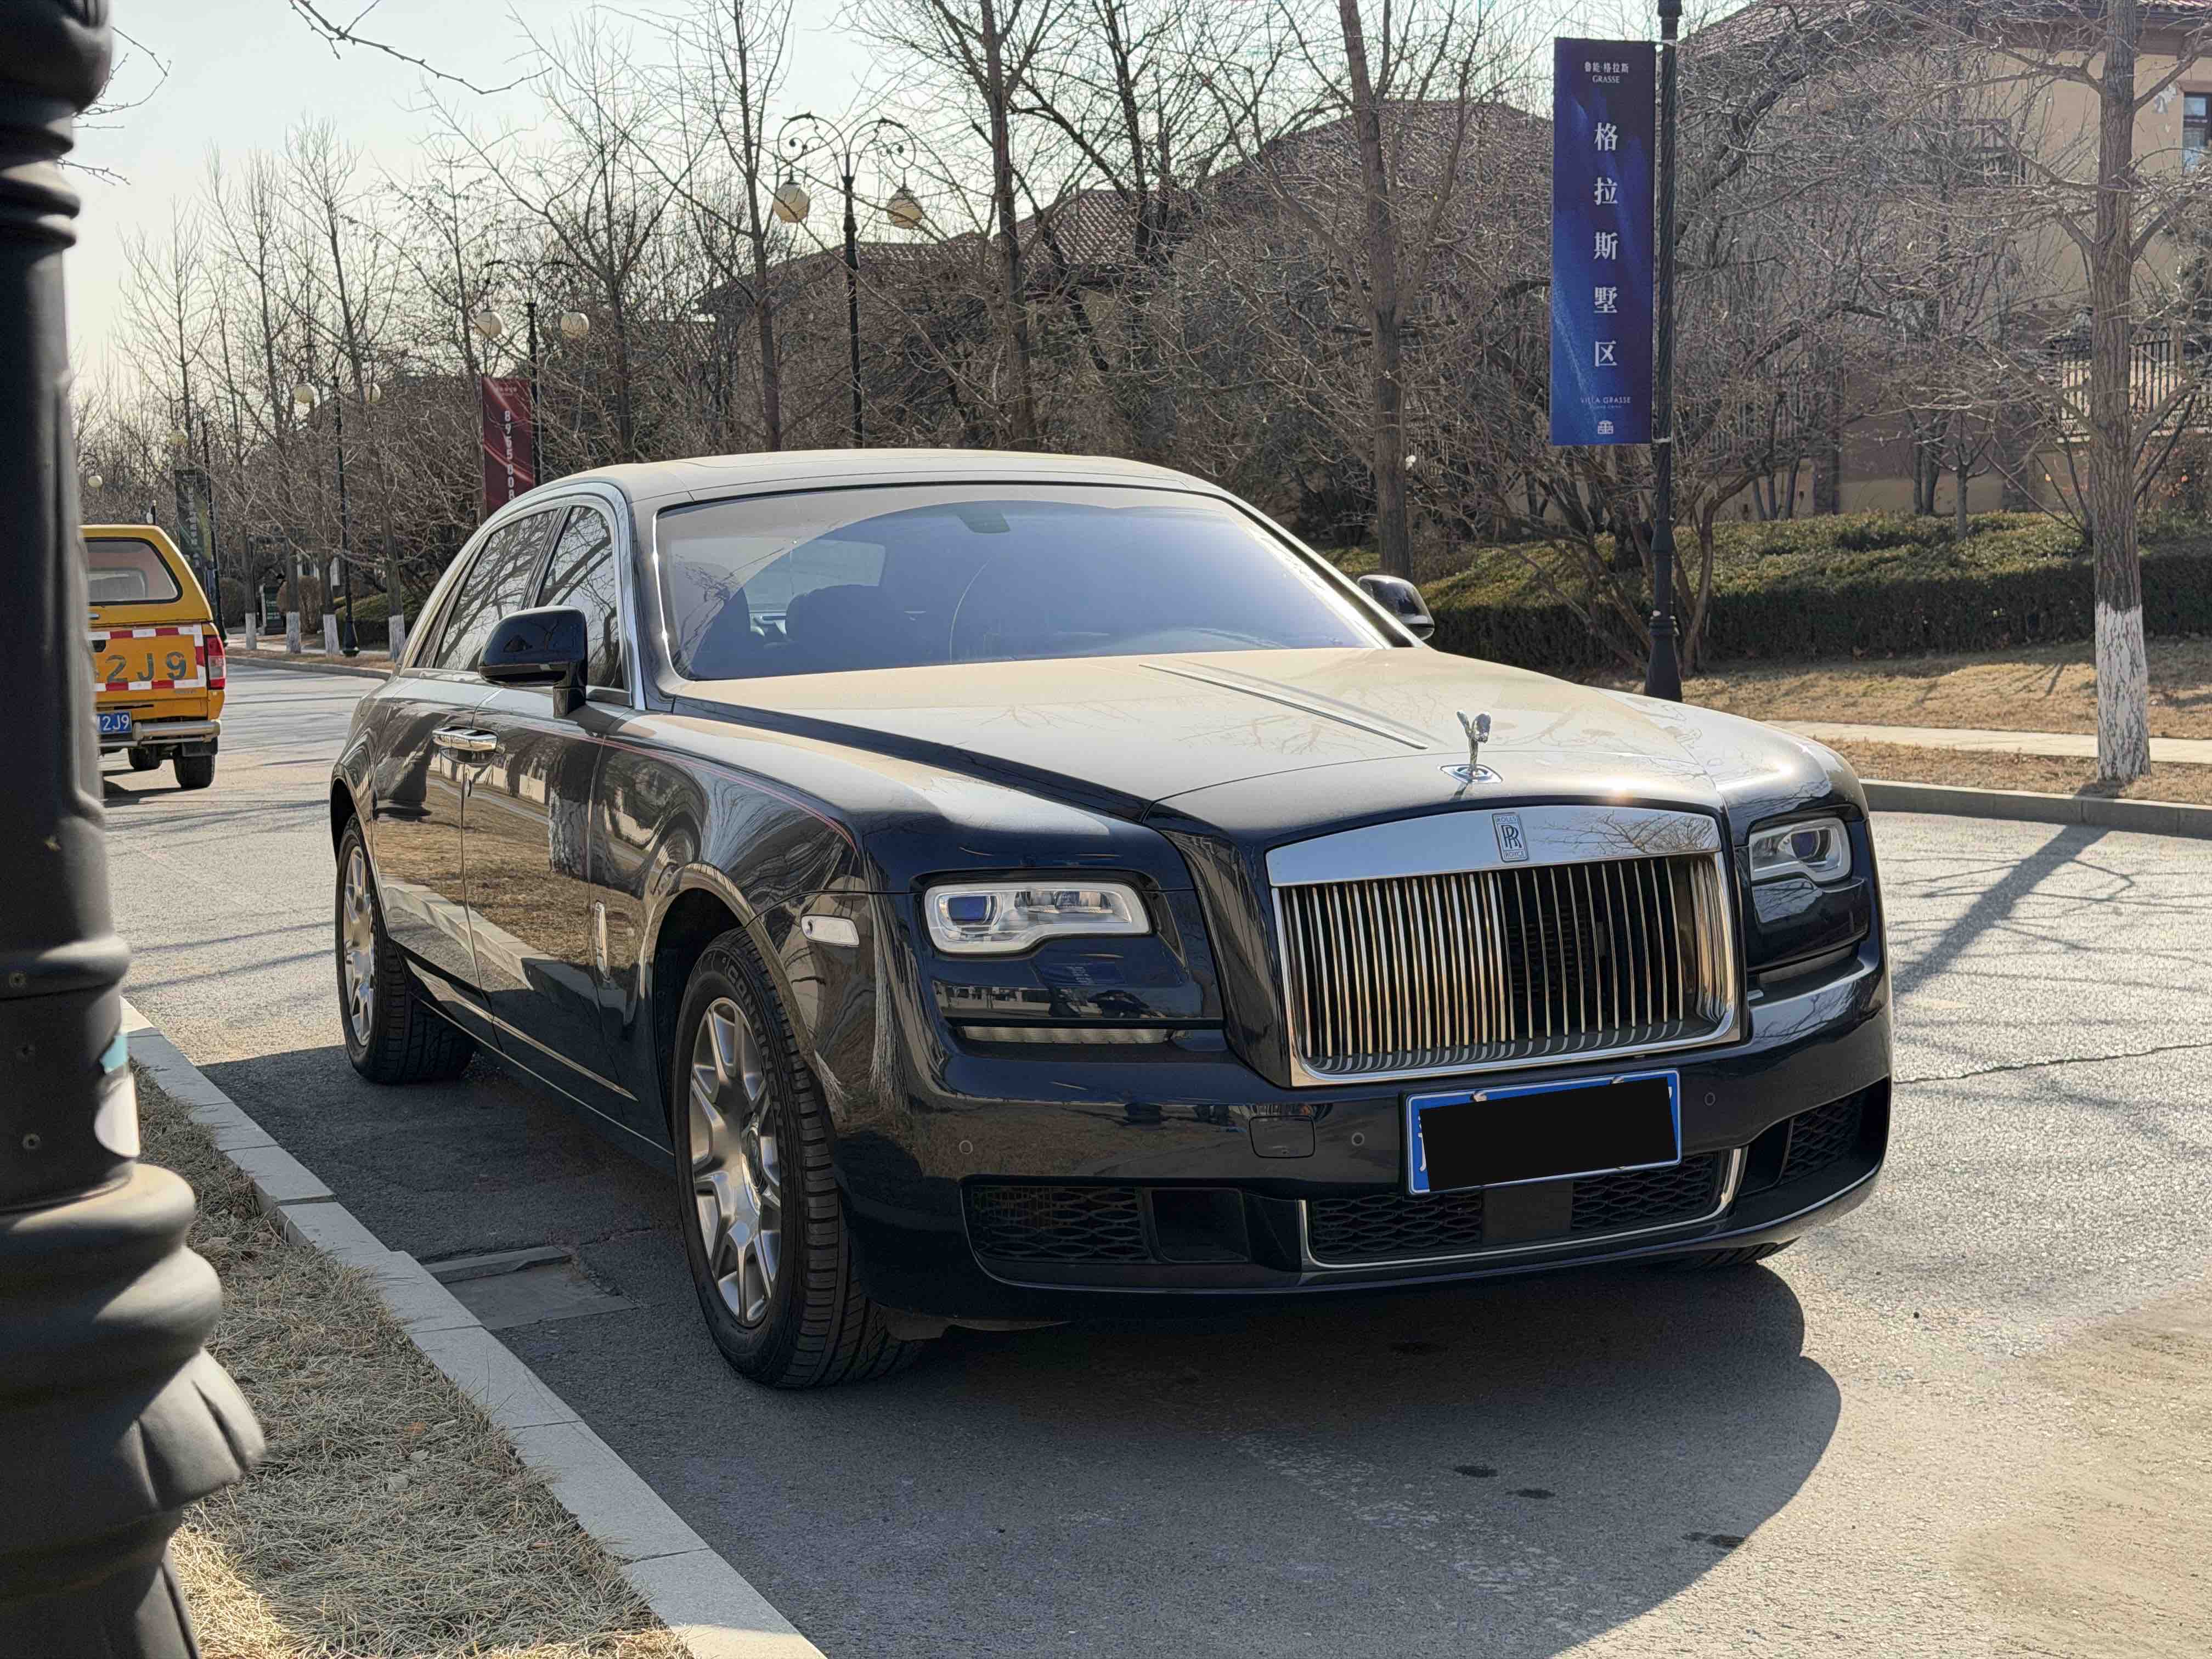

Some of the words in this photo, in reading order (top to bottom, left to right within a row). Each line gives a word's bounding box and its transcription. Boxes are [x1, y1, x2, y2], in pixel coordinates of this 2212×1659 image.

[1592, 75, 1620, 83] GRASSE
[1593, 122, 1618, 368] 格拉斯墅区
[97, 651, 187, 683] 2J9
